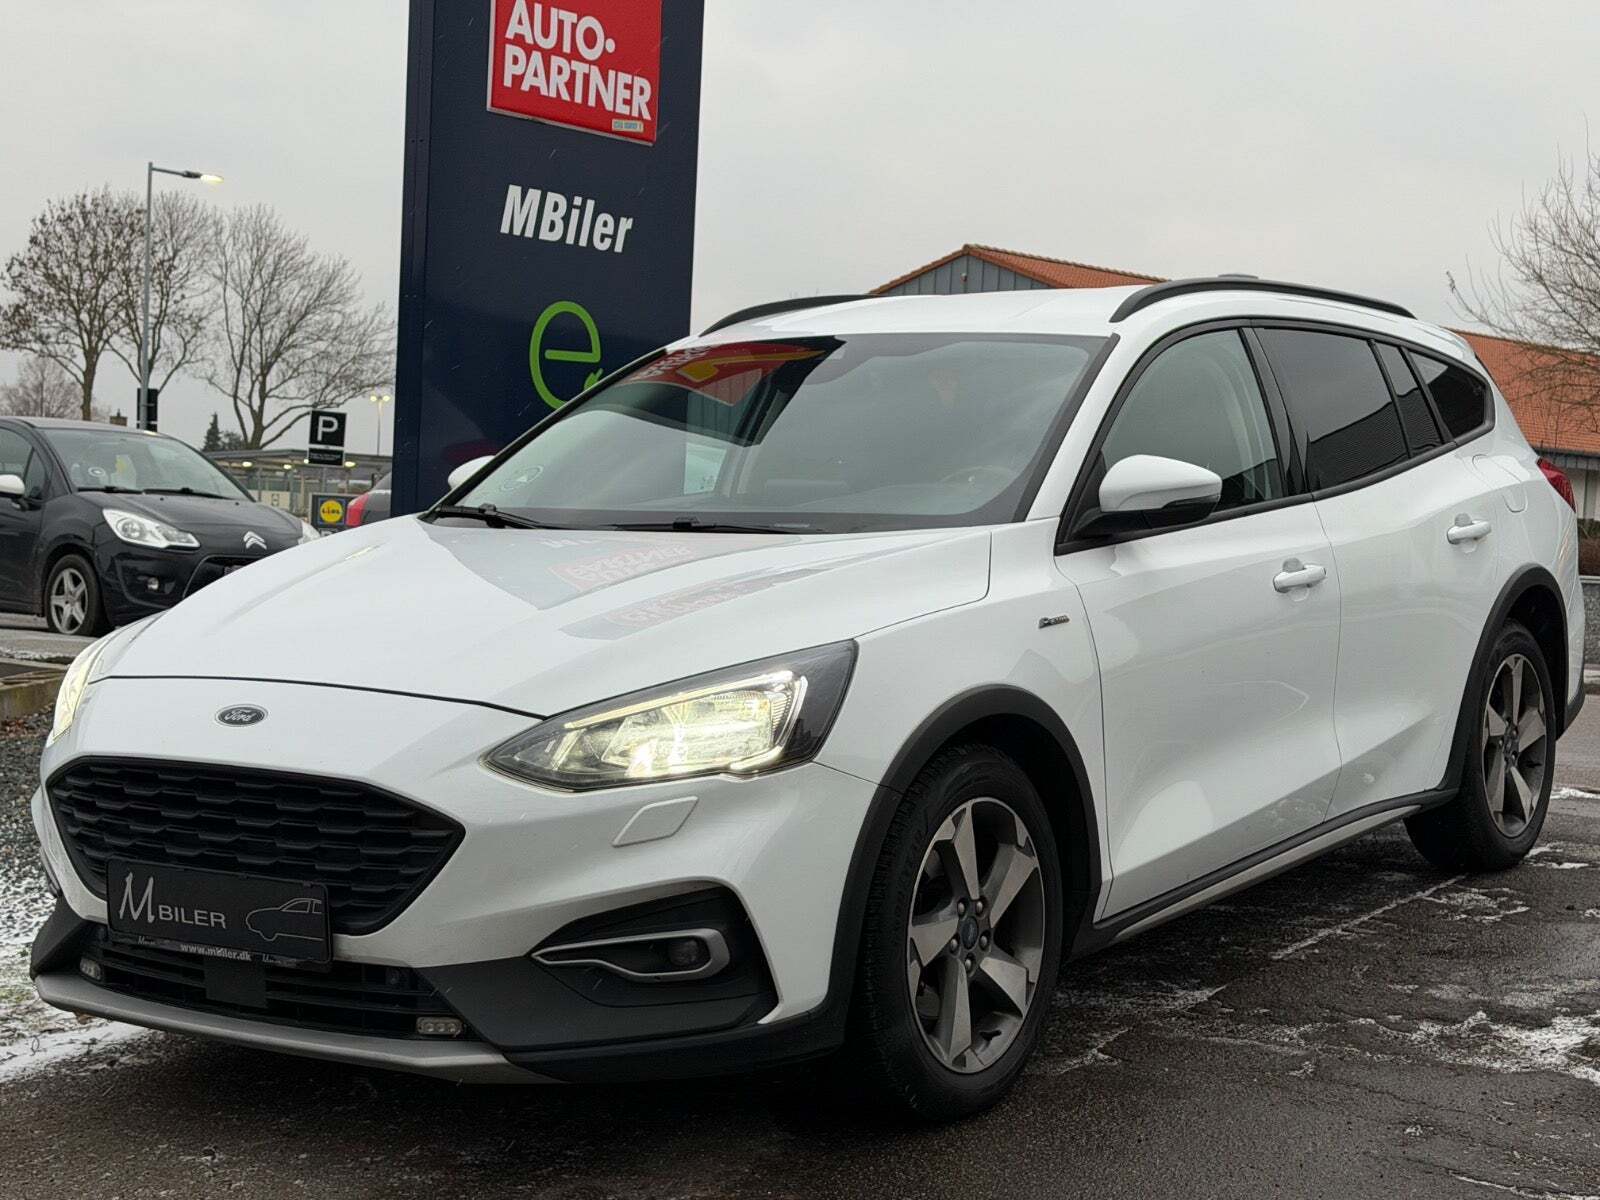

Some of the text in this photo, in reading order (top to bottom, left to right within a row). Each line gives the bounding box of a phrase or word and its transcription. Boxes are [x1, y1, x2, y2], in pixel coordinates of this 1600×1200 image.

[503, 43, 652, 120] PARTNER
[500, 184, 633, 253] MBiler
[317, 415, 339, 441] P
